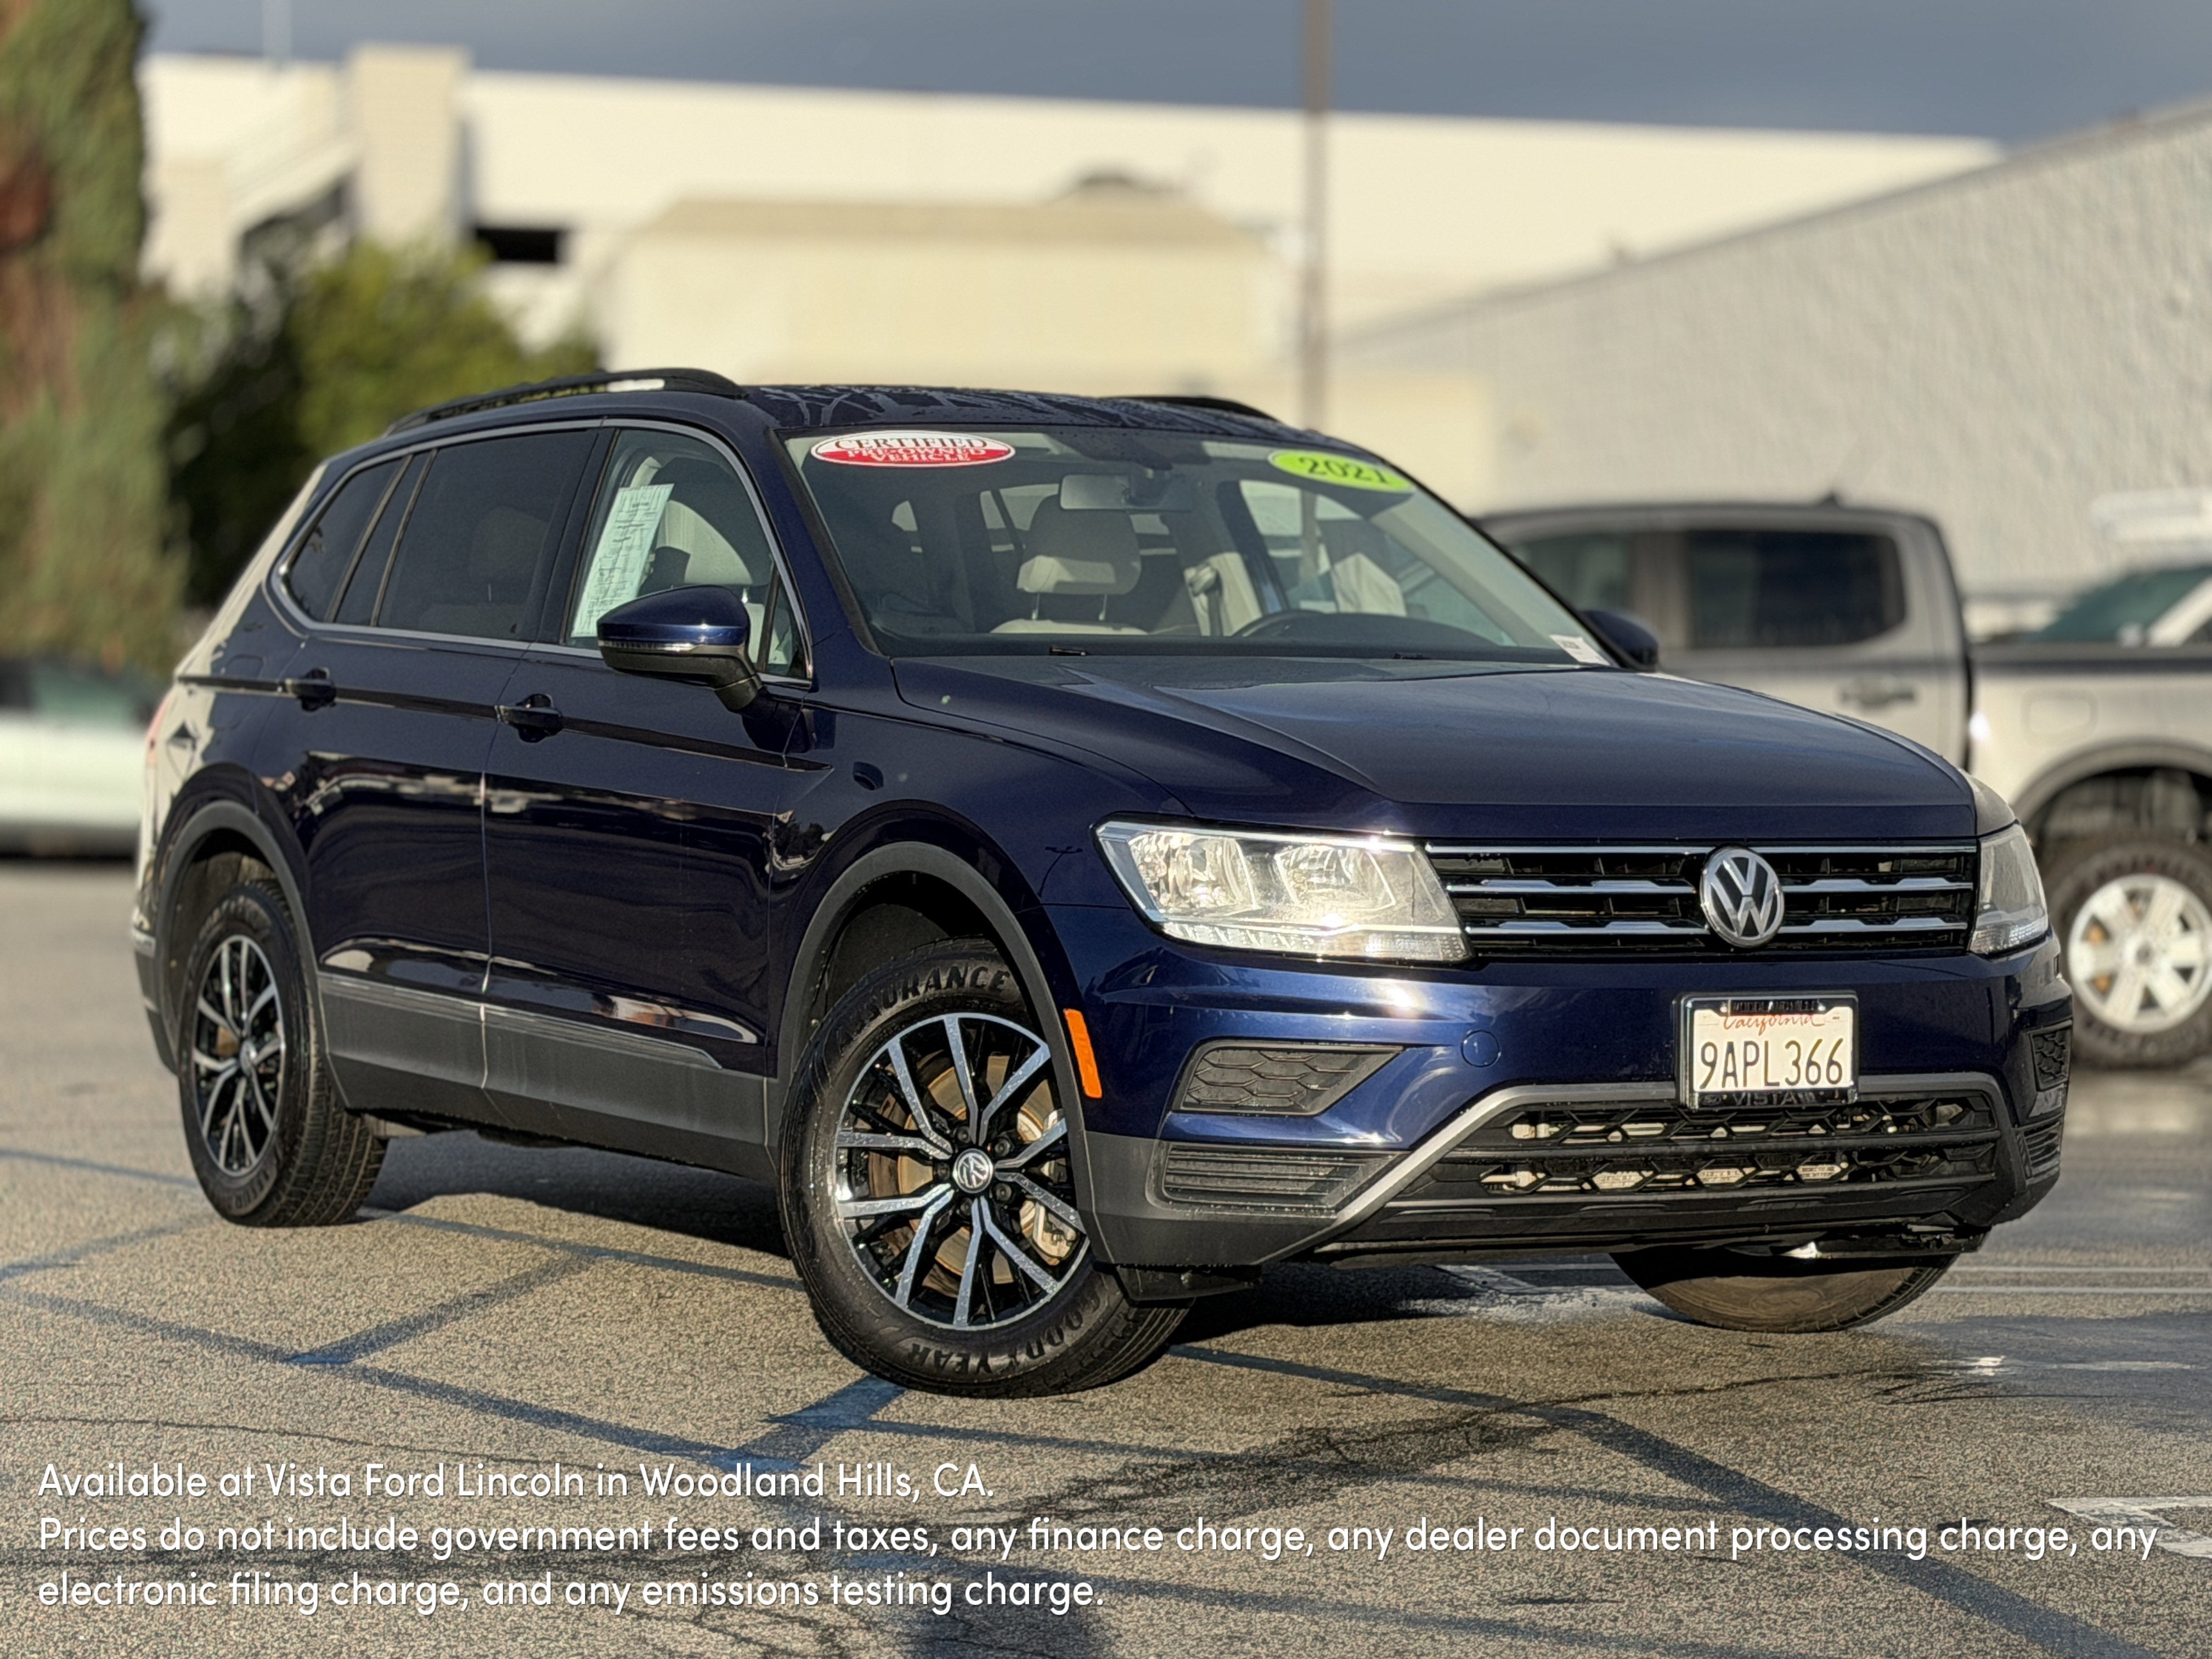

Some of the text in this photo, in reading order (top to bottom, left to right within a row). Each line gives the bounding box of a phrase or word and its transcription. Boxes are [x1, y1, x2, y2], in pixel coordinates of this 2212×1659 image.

[834, 438, 988, 449] CERTIFIED
[847, 447, 986, 458] PRE-OWNED
[872, 453, 972, 462] VEHICLE
[1299, 456, 1387, 484] 2021
[1699, 1037, 1844, 1090] 9APL366
